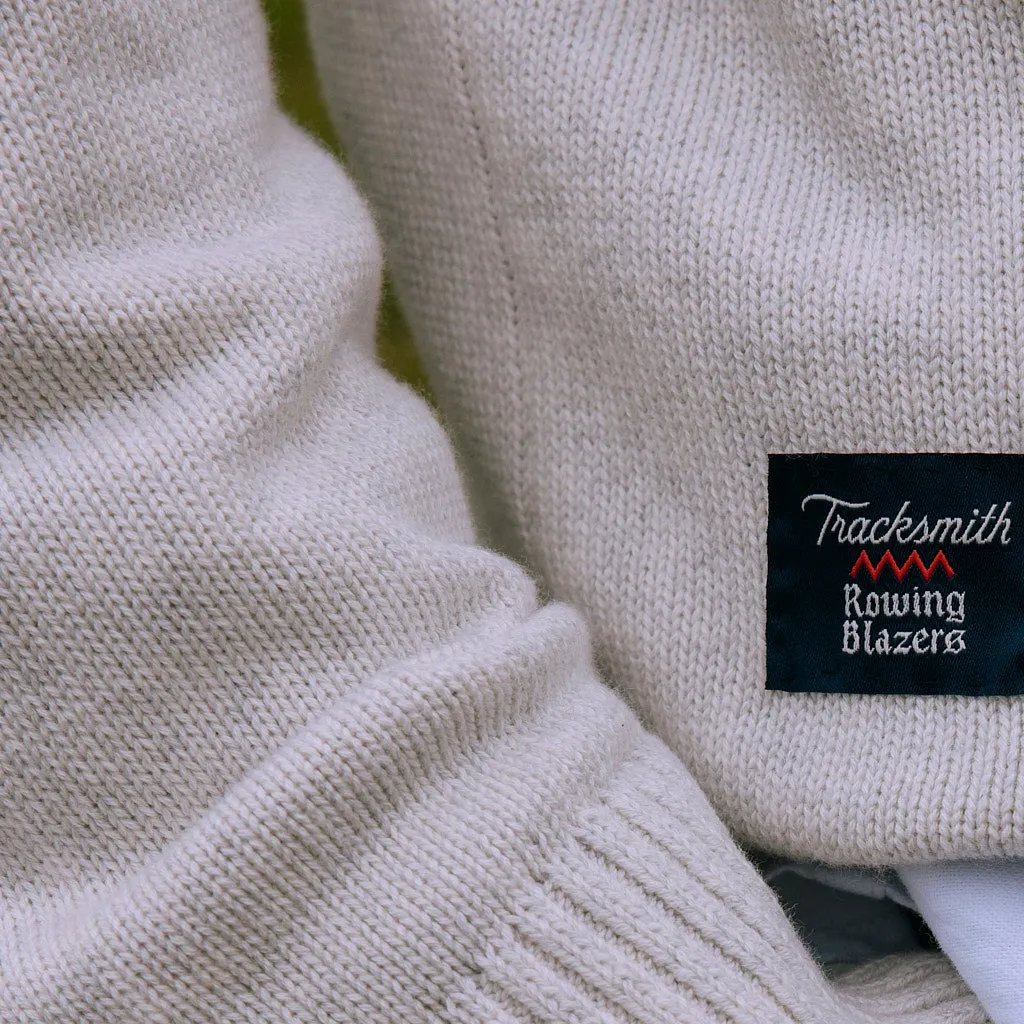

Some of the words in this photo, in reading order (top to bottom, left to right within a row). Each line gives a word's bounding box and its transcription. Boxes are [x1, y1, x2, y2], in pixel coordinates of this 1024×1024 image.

[801, 493, 1012, 545] Tracksmith
[843, 583, 966, 622] Rowing
[841, 620, 967, 655] Blazers
